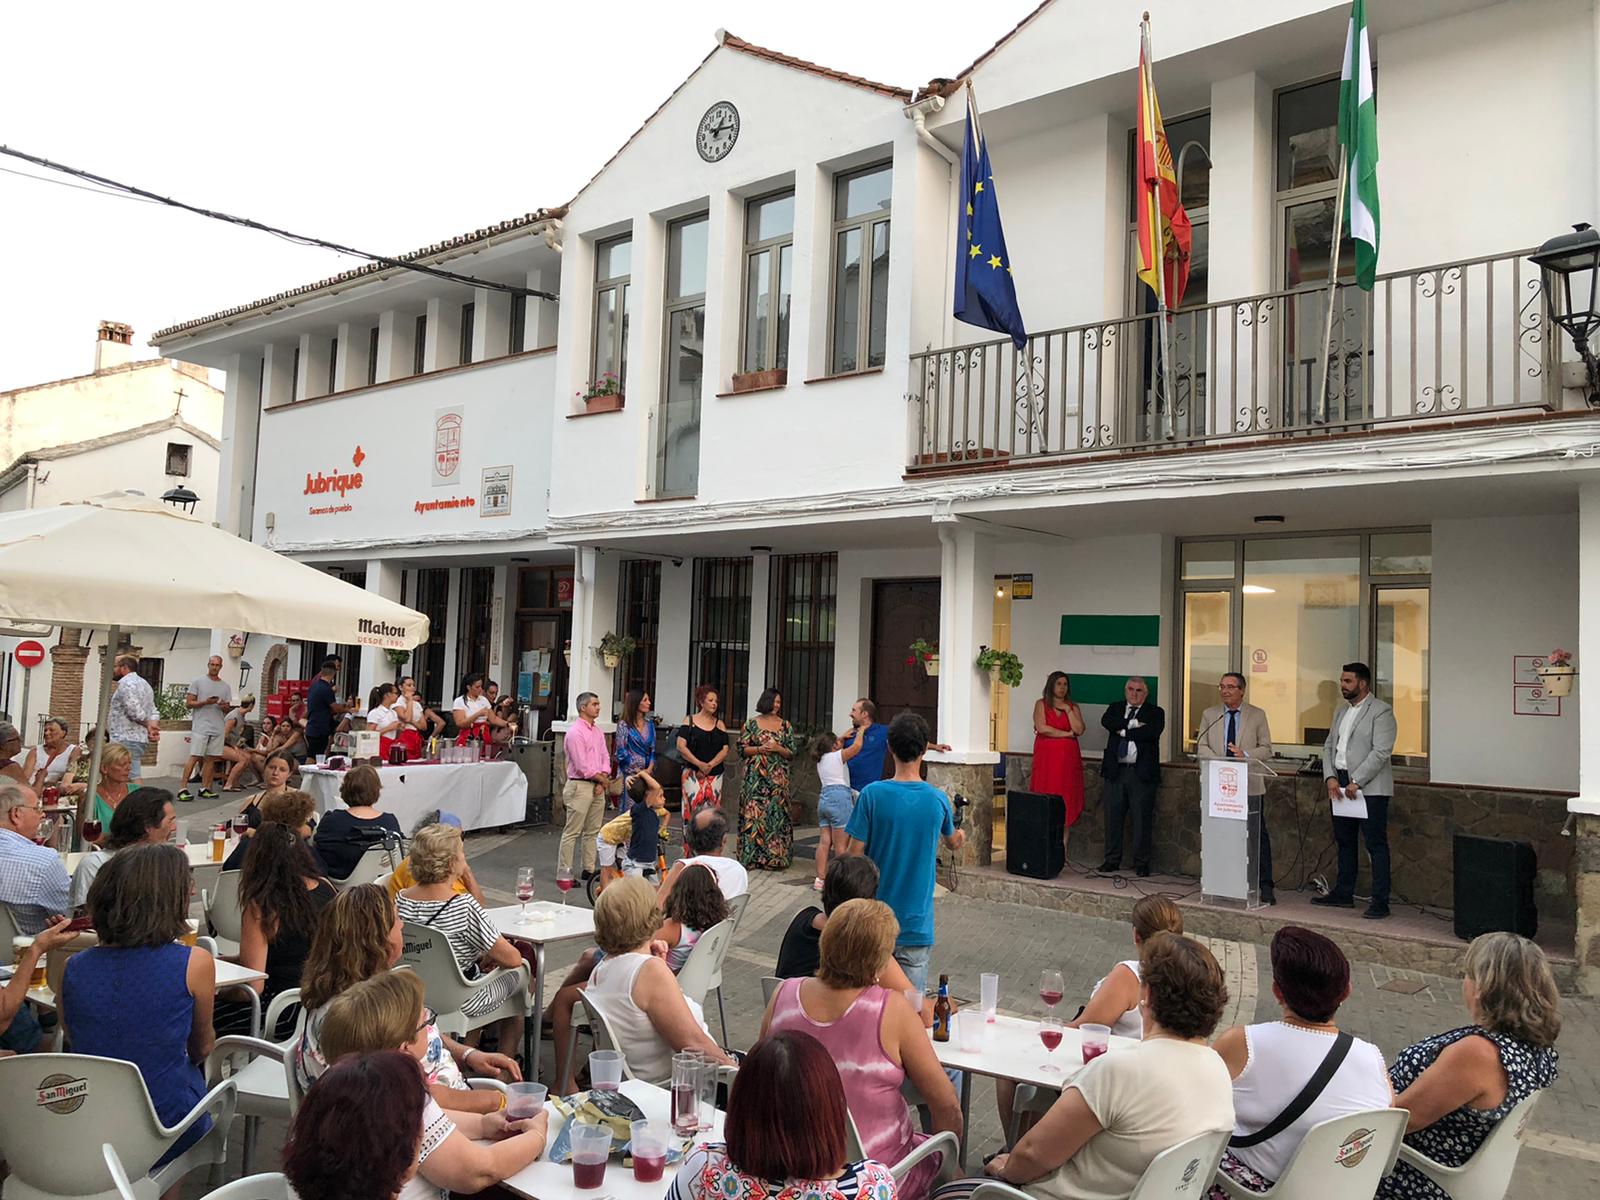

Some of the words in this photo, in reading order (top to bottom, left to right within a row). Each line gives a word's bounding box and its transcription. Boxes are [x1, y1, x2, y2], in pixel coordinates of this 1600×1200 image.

[303, 468, 363, 498] Jubrique
[414, 496, 475, 515] Ayuntamiento
[358, 618, 406, 637] Mahou
[357, 636, 383, 646] DESDE
